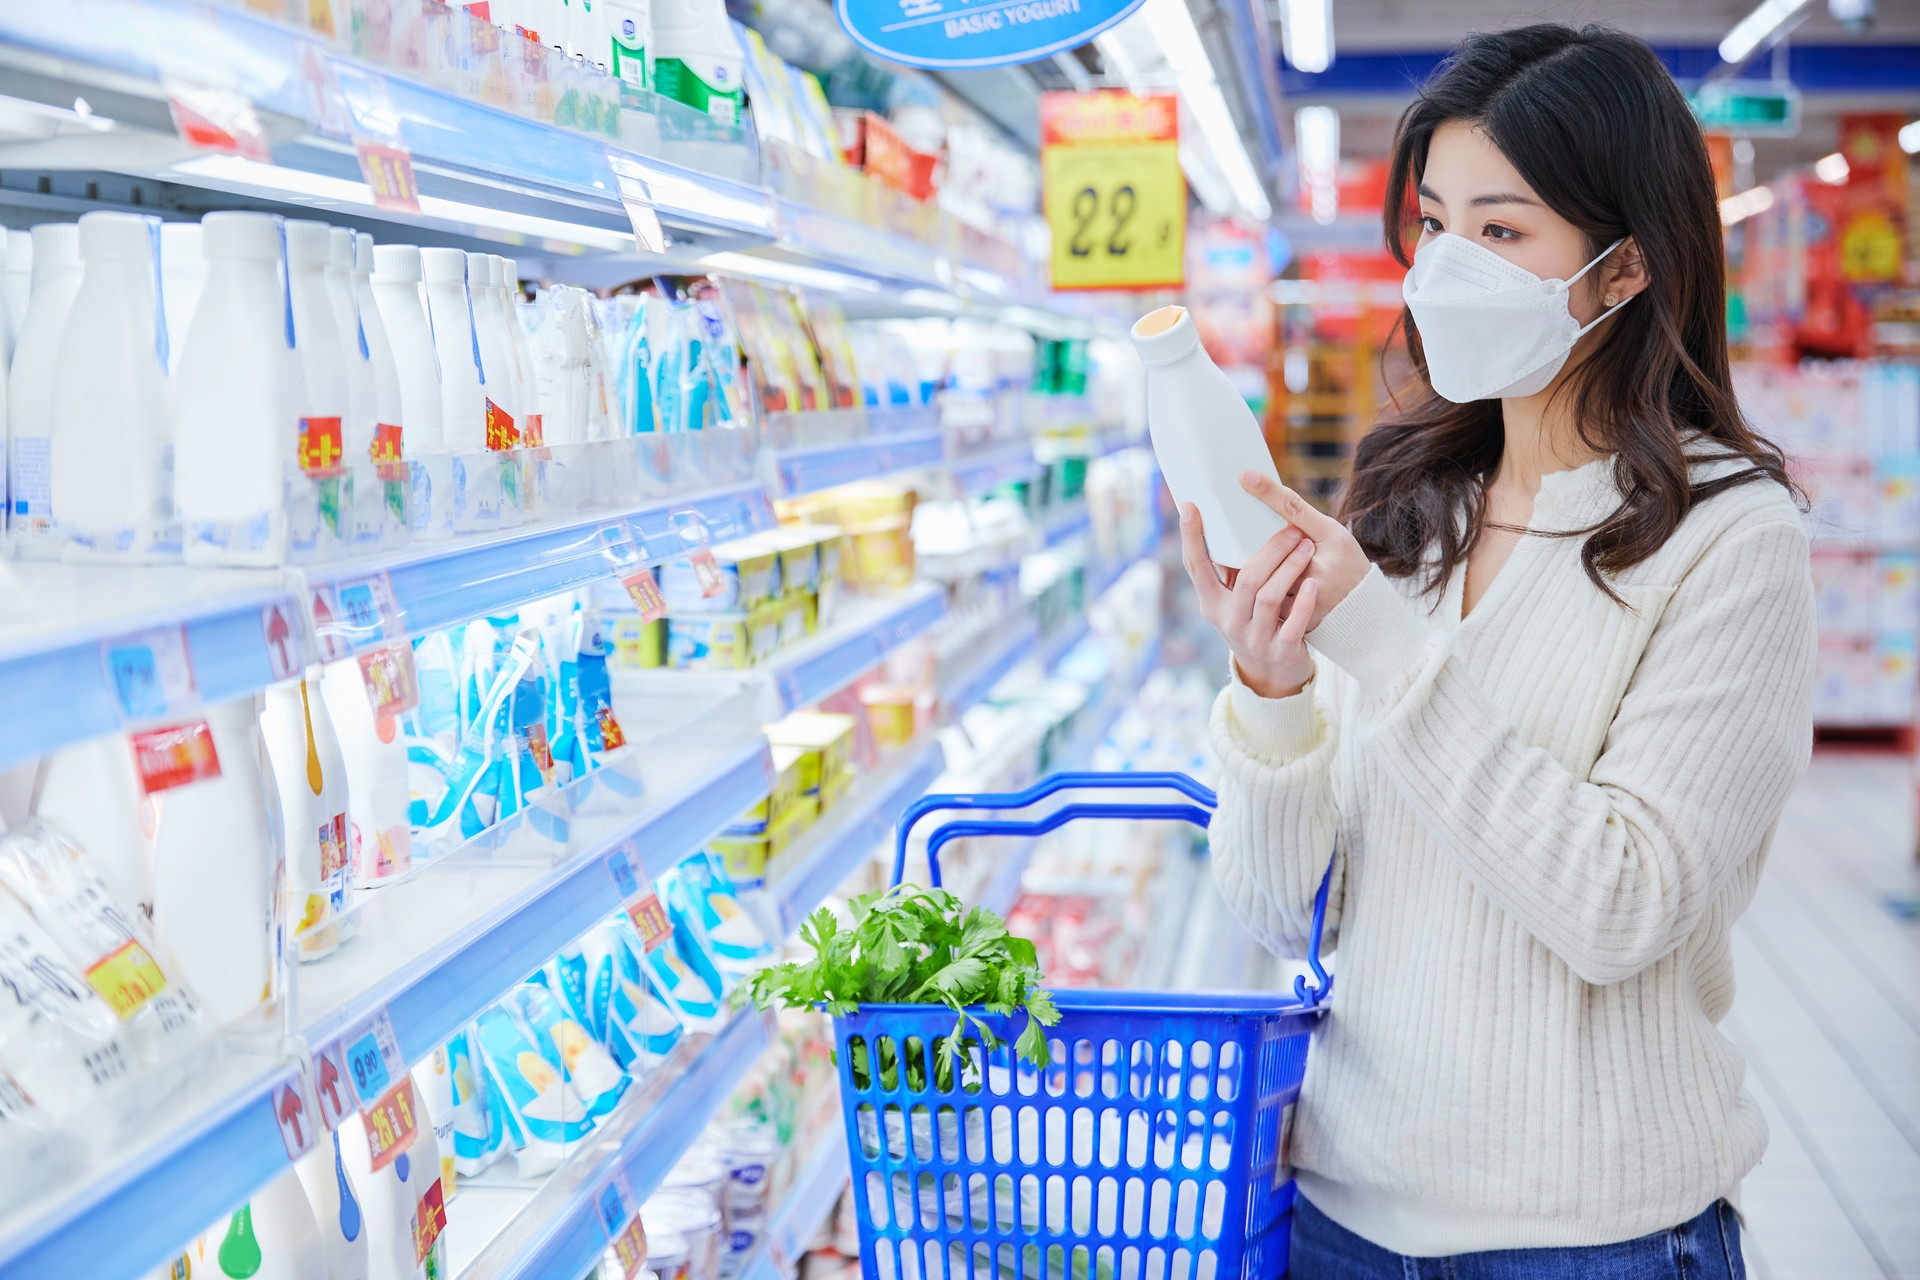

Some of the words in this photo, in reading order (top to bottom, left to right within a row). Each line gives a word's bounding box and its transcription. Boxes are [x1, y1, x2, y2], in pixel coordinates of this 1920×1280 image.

[943, 11, 1004, 40] BASIC
[1003, 0, 1081, 27] YOGURT
[1068, 185, 1137, 257] 22
